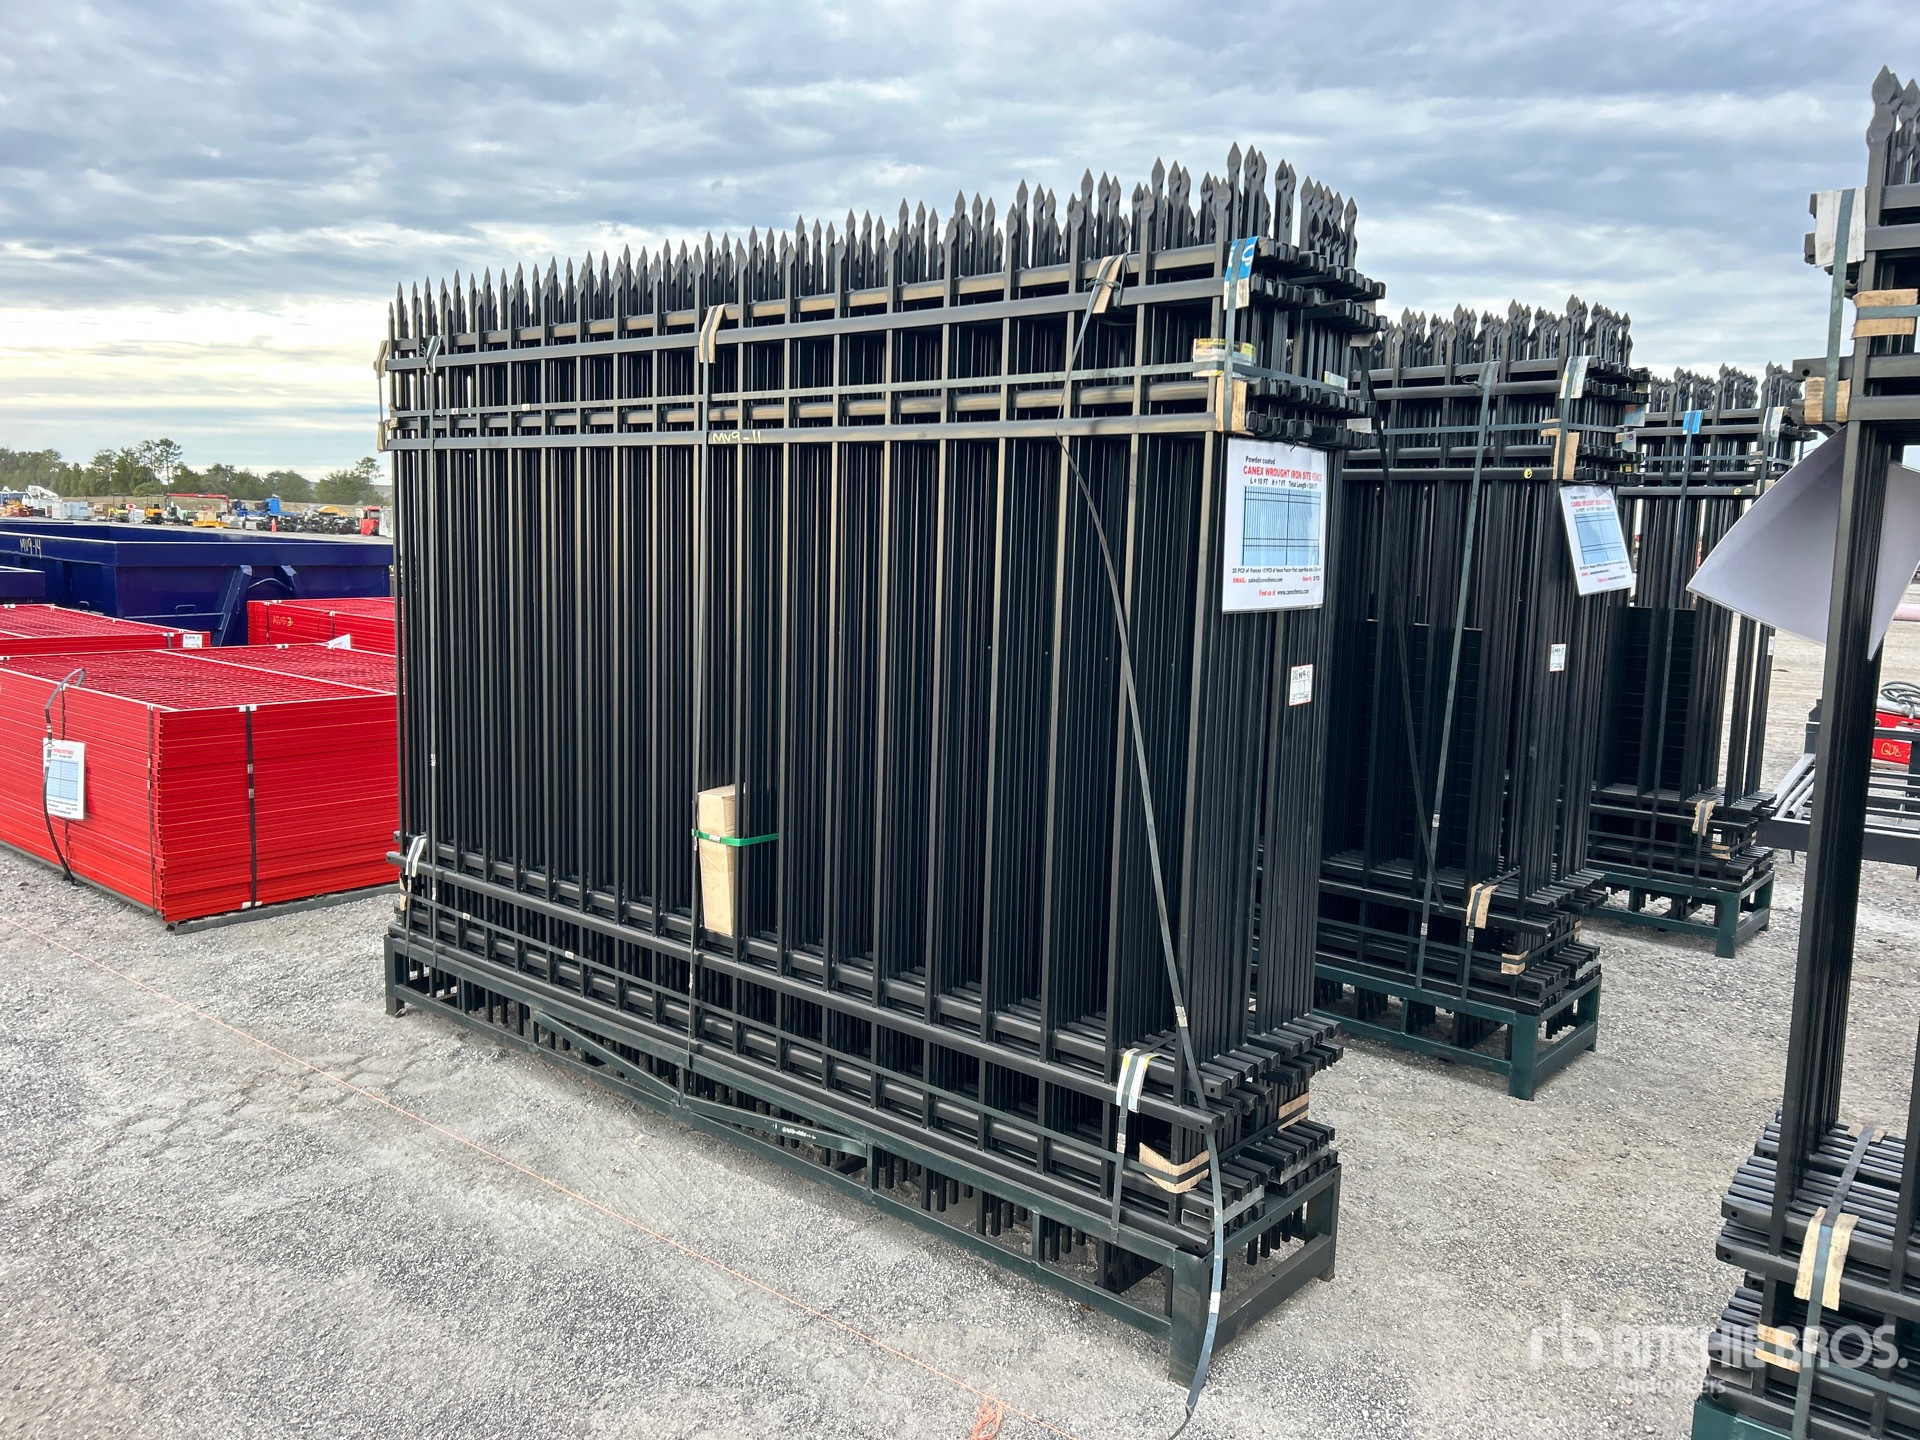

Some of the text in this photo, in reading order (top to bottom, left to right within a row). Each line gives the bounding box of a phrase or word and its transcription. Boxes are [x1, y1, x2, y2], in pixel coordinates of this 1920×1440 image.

[1245, 455, 1262, 464] Powder
[1243, 465, 1264, 476] CANEX
[1265, 467, 1290, 478] WROUGHT
[1291, 470, 1302, 479] IRON
[1302, 471, 1311, 481] SITE
[1288, 480, 1296, 488] Total
[1297, 481, 1306, 490] Length
